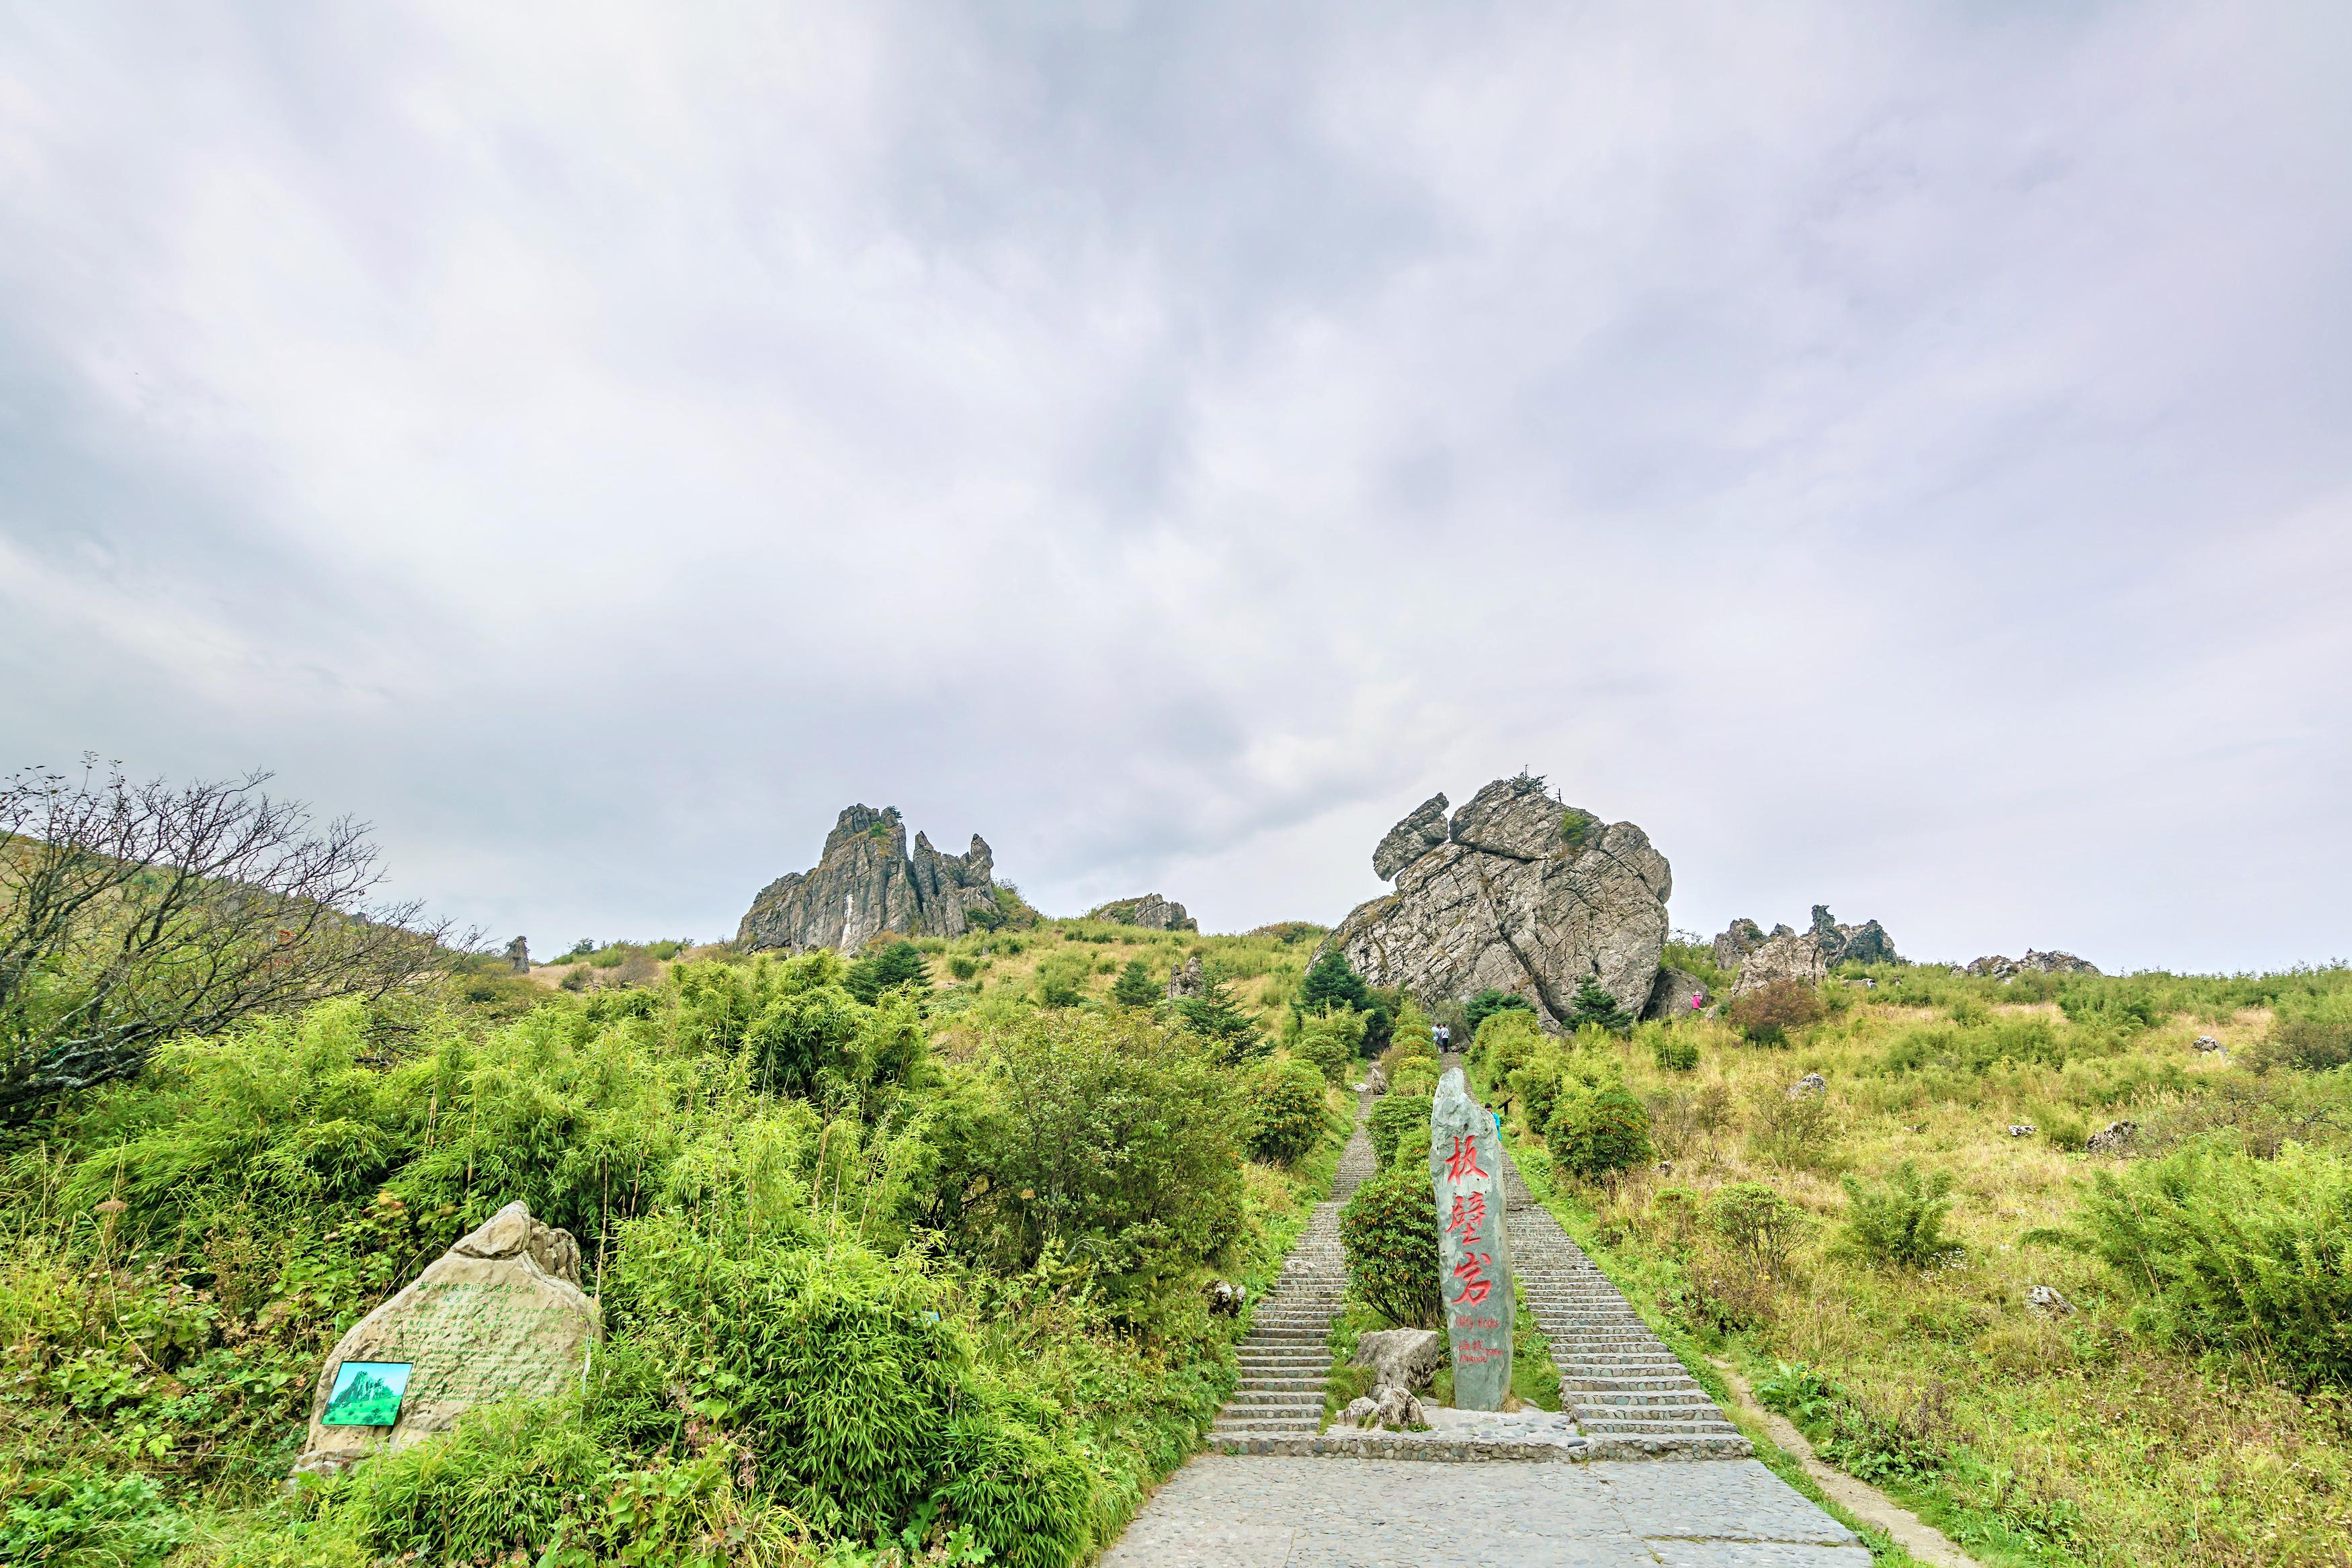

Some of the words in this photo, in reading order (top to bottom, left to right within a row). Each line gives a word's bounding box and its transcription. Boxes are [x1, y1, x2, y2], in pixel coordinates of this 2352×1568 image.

[1445, 1135, 1493, 1308] 板壁岩
[1478, 1316, 1500, 1328] Rocks
[1459, 1354, 1488, 1365] Altitude
